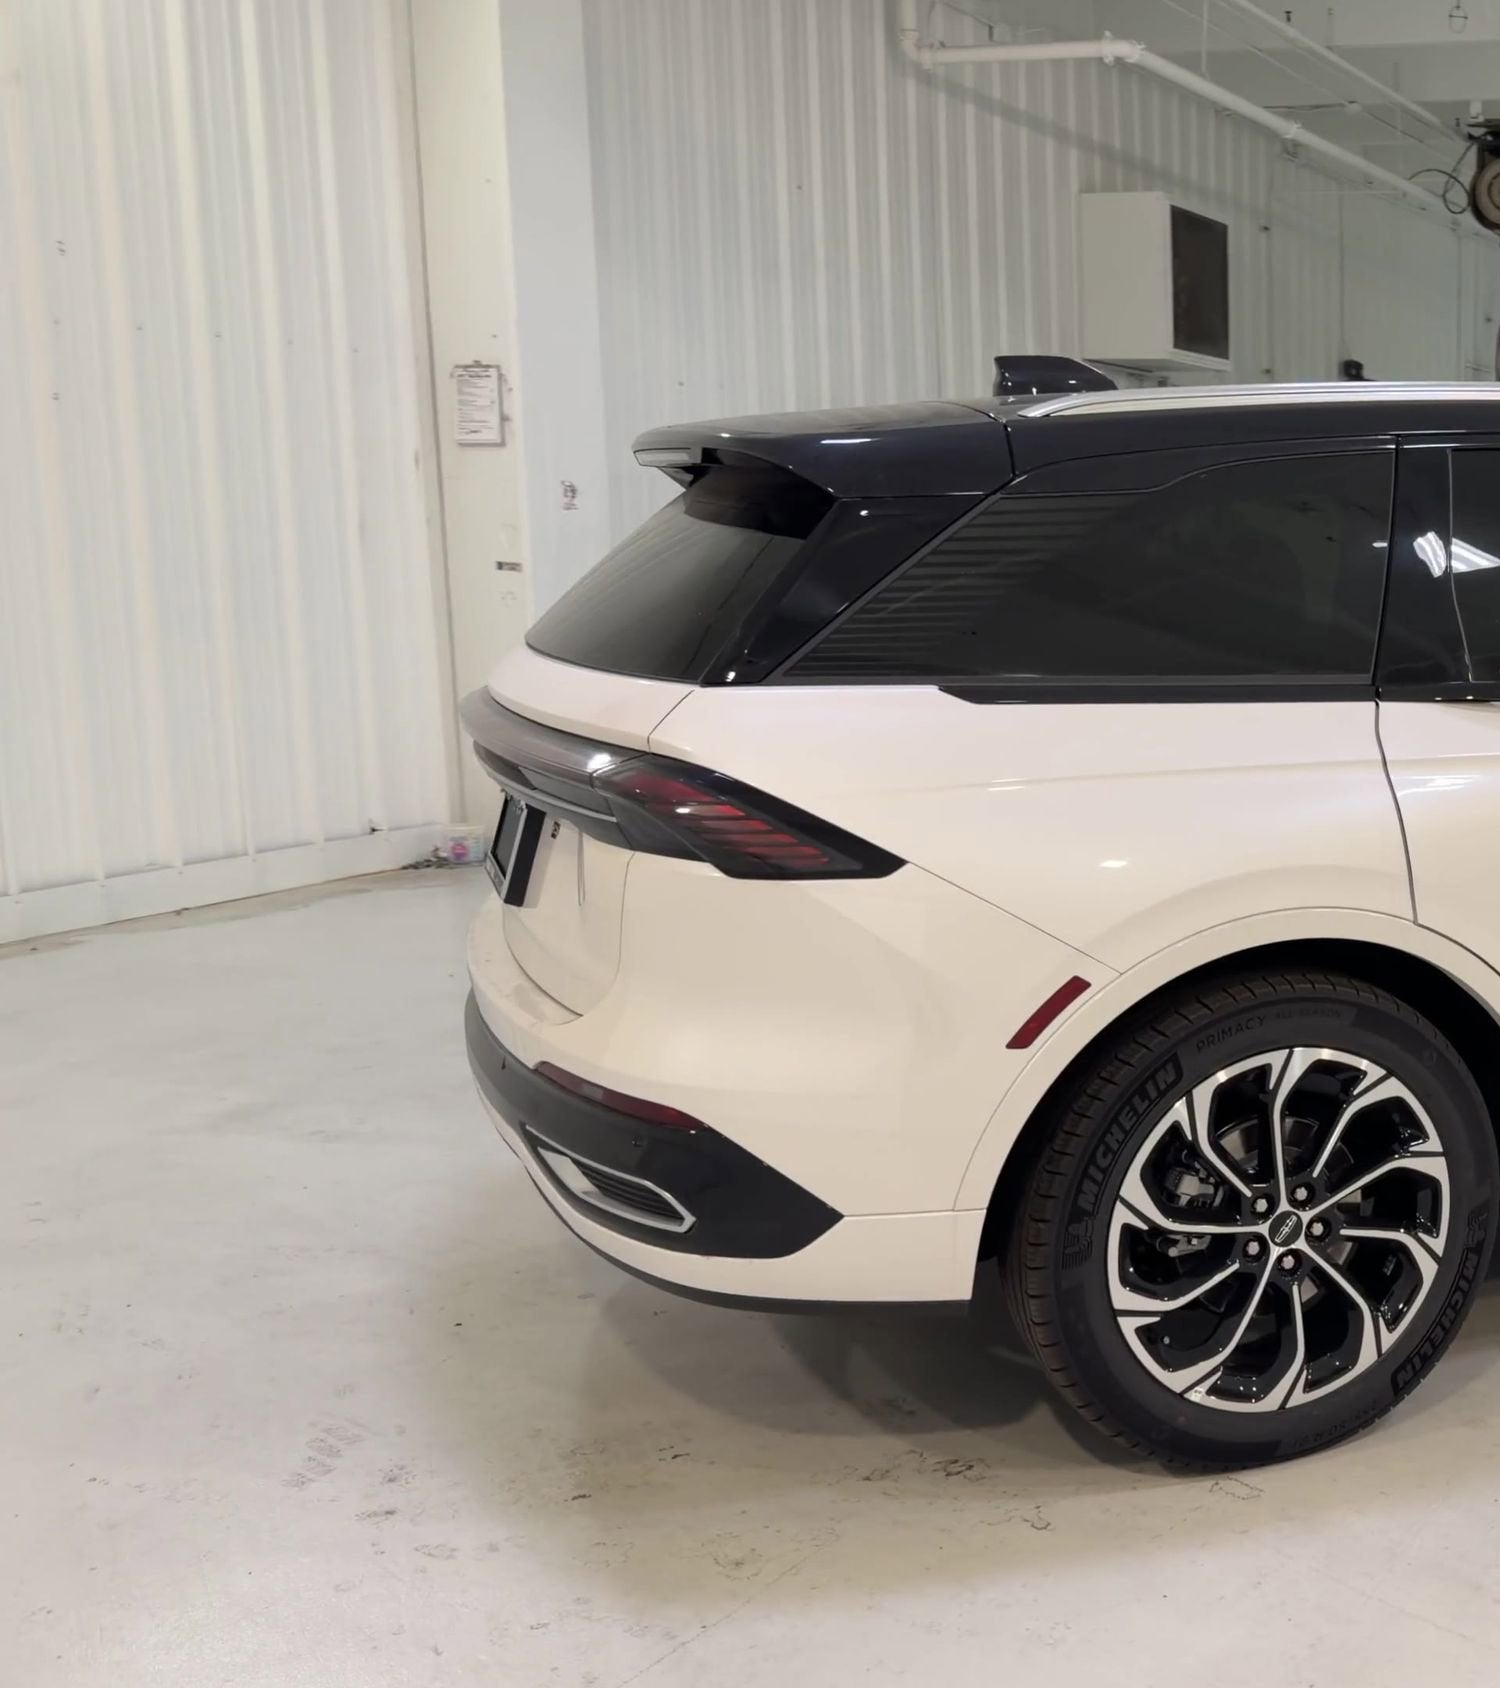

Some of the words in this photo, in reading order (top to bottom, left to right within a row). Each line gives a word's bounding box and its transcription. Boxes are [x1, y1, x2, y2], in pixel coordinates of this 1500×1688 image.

[1195, 1015, 1266, 1053] PRIMACY
[1077, 1062, 1178, 1213] MICHELIN
[1396, 1252, 1480, 1388] MICHELIN
